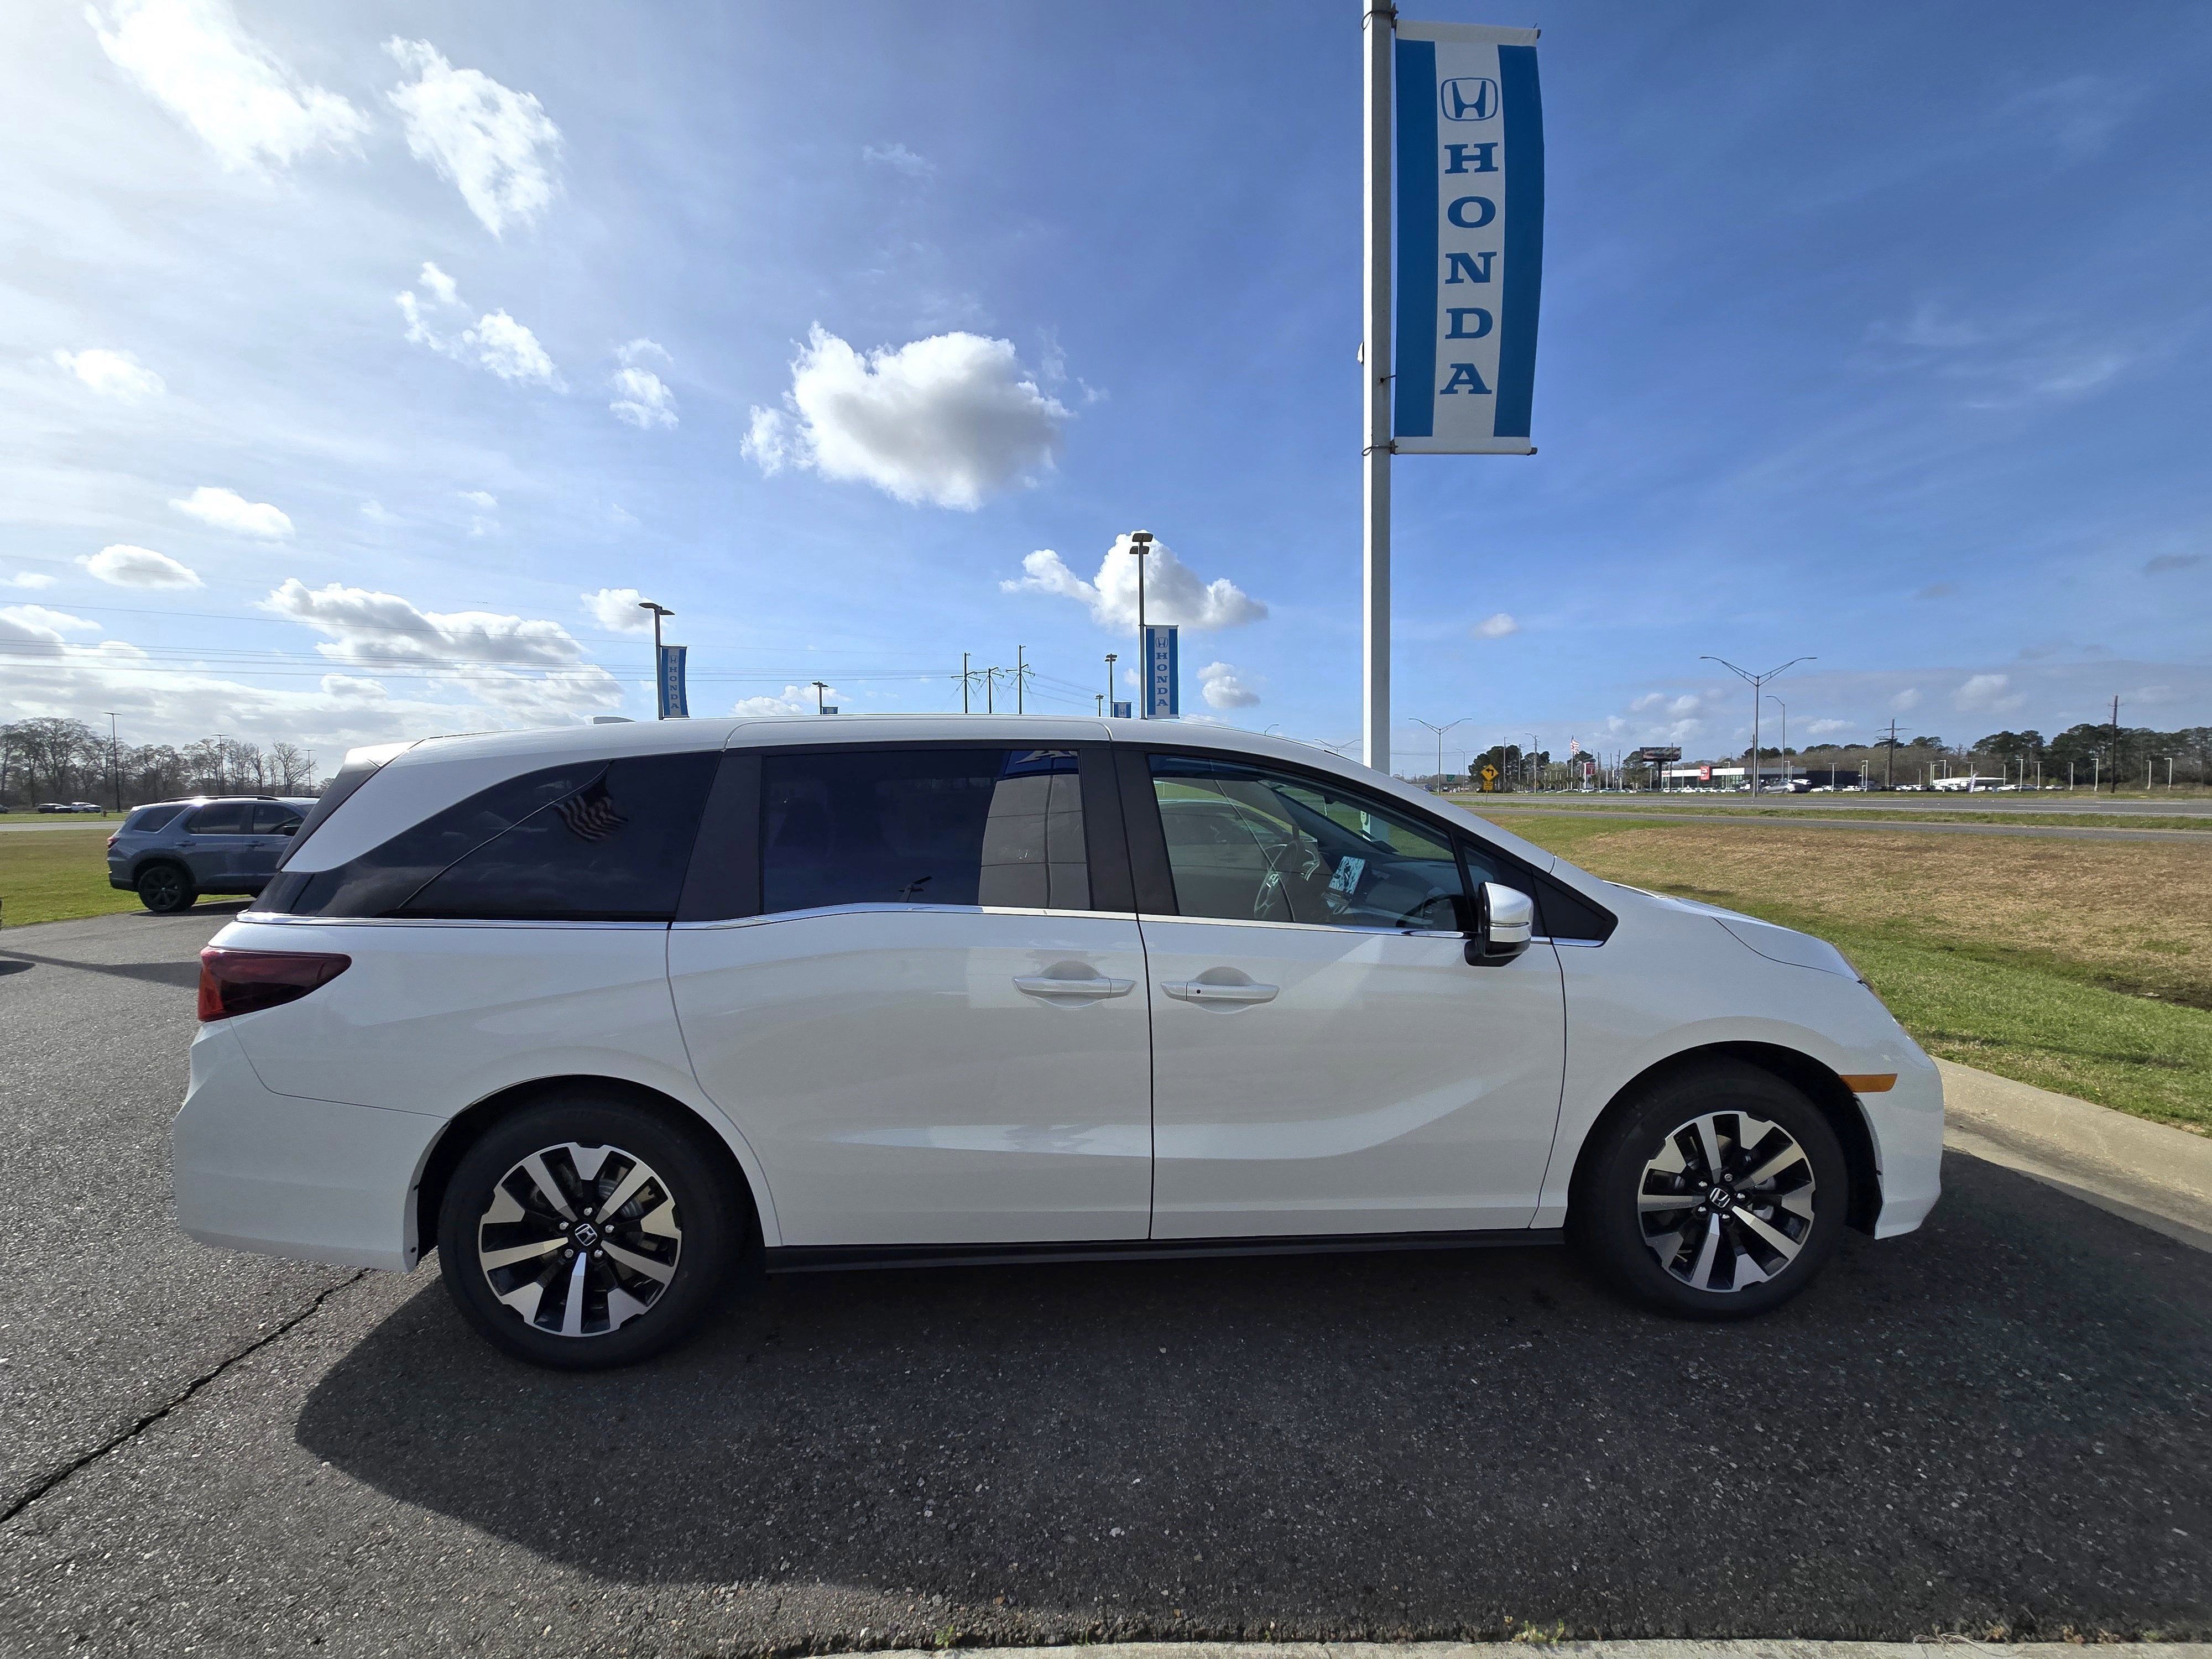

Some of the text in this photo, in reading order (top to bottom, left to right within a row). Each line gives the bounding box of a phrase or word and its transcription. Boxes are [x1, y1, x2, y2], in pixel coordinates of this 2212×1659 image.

[1440, 143, 1498, 395] HONDA
[670, 667, 679, 708] HONDA
[1156, 652, 1168, 706] HONDA
